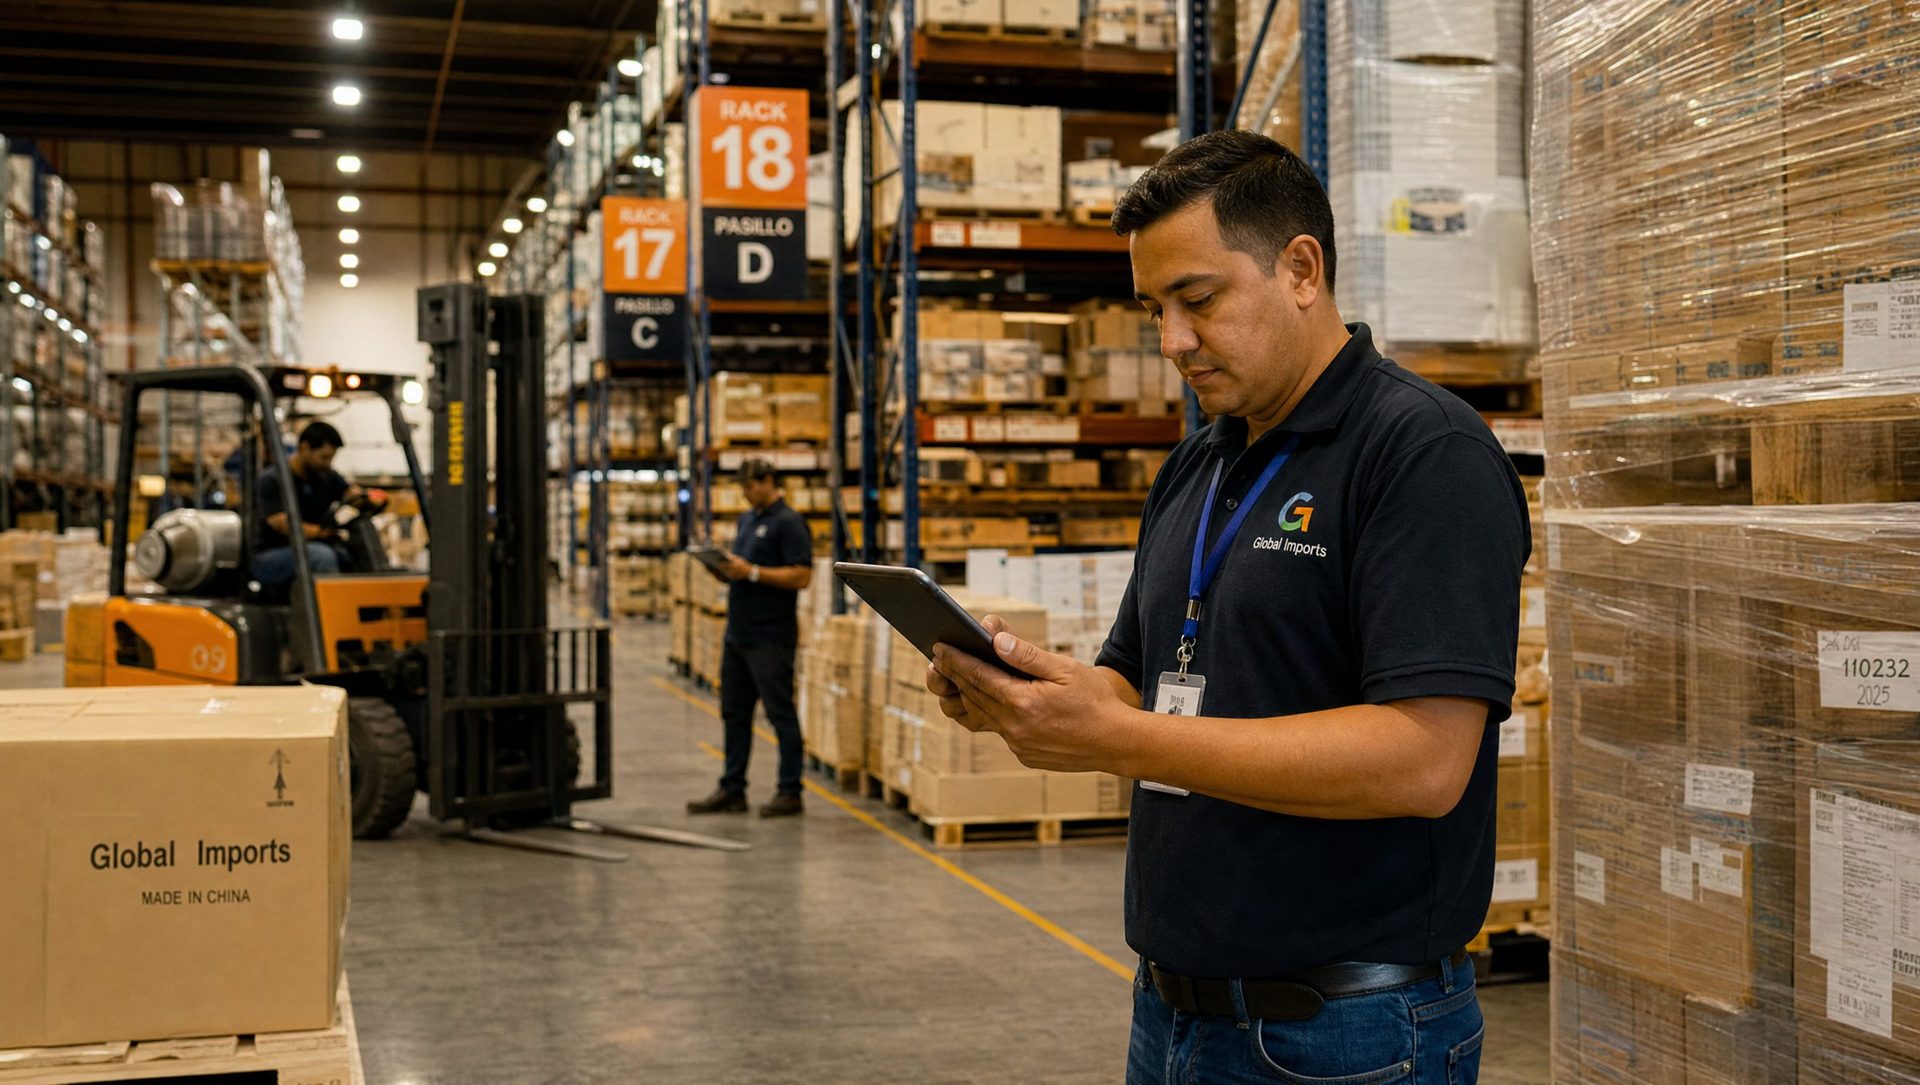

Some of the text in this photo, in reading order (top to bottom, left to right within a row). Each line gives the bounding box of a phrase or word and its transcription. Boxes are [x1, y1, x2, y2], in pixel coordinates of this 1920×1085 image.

[719, 100, 787, 121] RACK
[712, 126, 794, 191] 18
[619, 207, 671, 225] RACK
[714, 216, 793, 236] PASILLO
[614, 228, 675, 280] 17
[737, 242, 774, 283] D
[615, 298, 674, 314] PASILLO
[631, 317, 659, 349] C
[1253, 536, 1327, 558] Global Imports
[191, 644, 227, 674] 09
[1843, 658, 1911, 678] 110232
[1857, 684, 1891, 706] 2025
[90, 839, 291, 872] Global Imports
[142, 889, 251, 905] MADE IN CHINA
